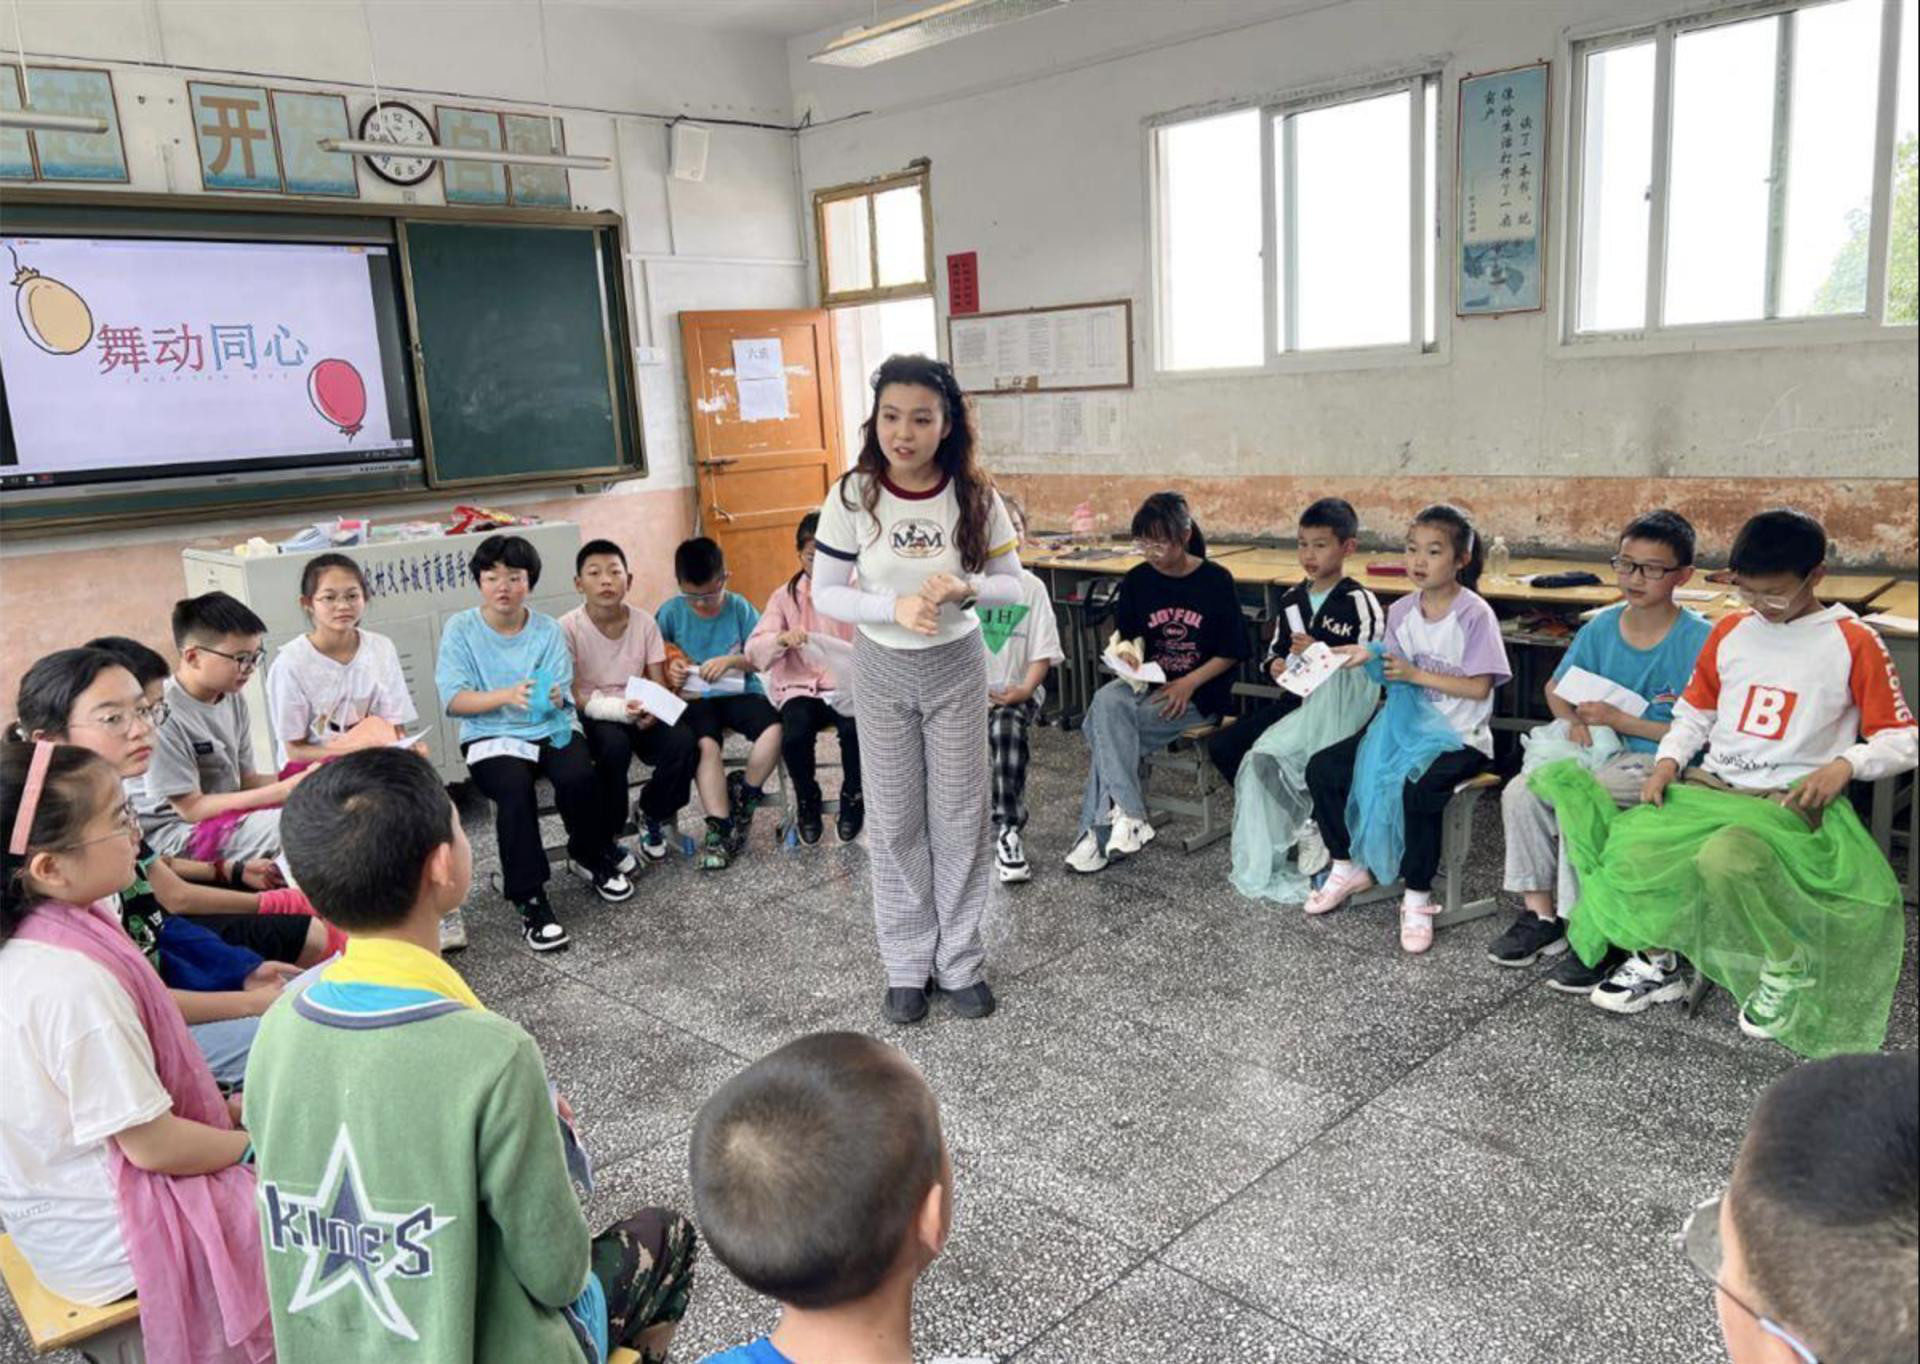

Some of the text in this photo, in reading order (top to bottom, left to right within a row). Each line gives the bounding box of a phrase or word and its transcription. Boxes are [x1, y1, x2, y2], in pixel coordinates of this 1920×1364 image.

[96, 322, 310, 375] 舞动同心
[1743, 686, 1786, 738] B
